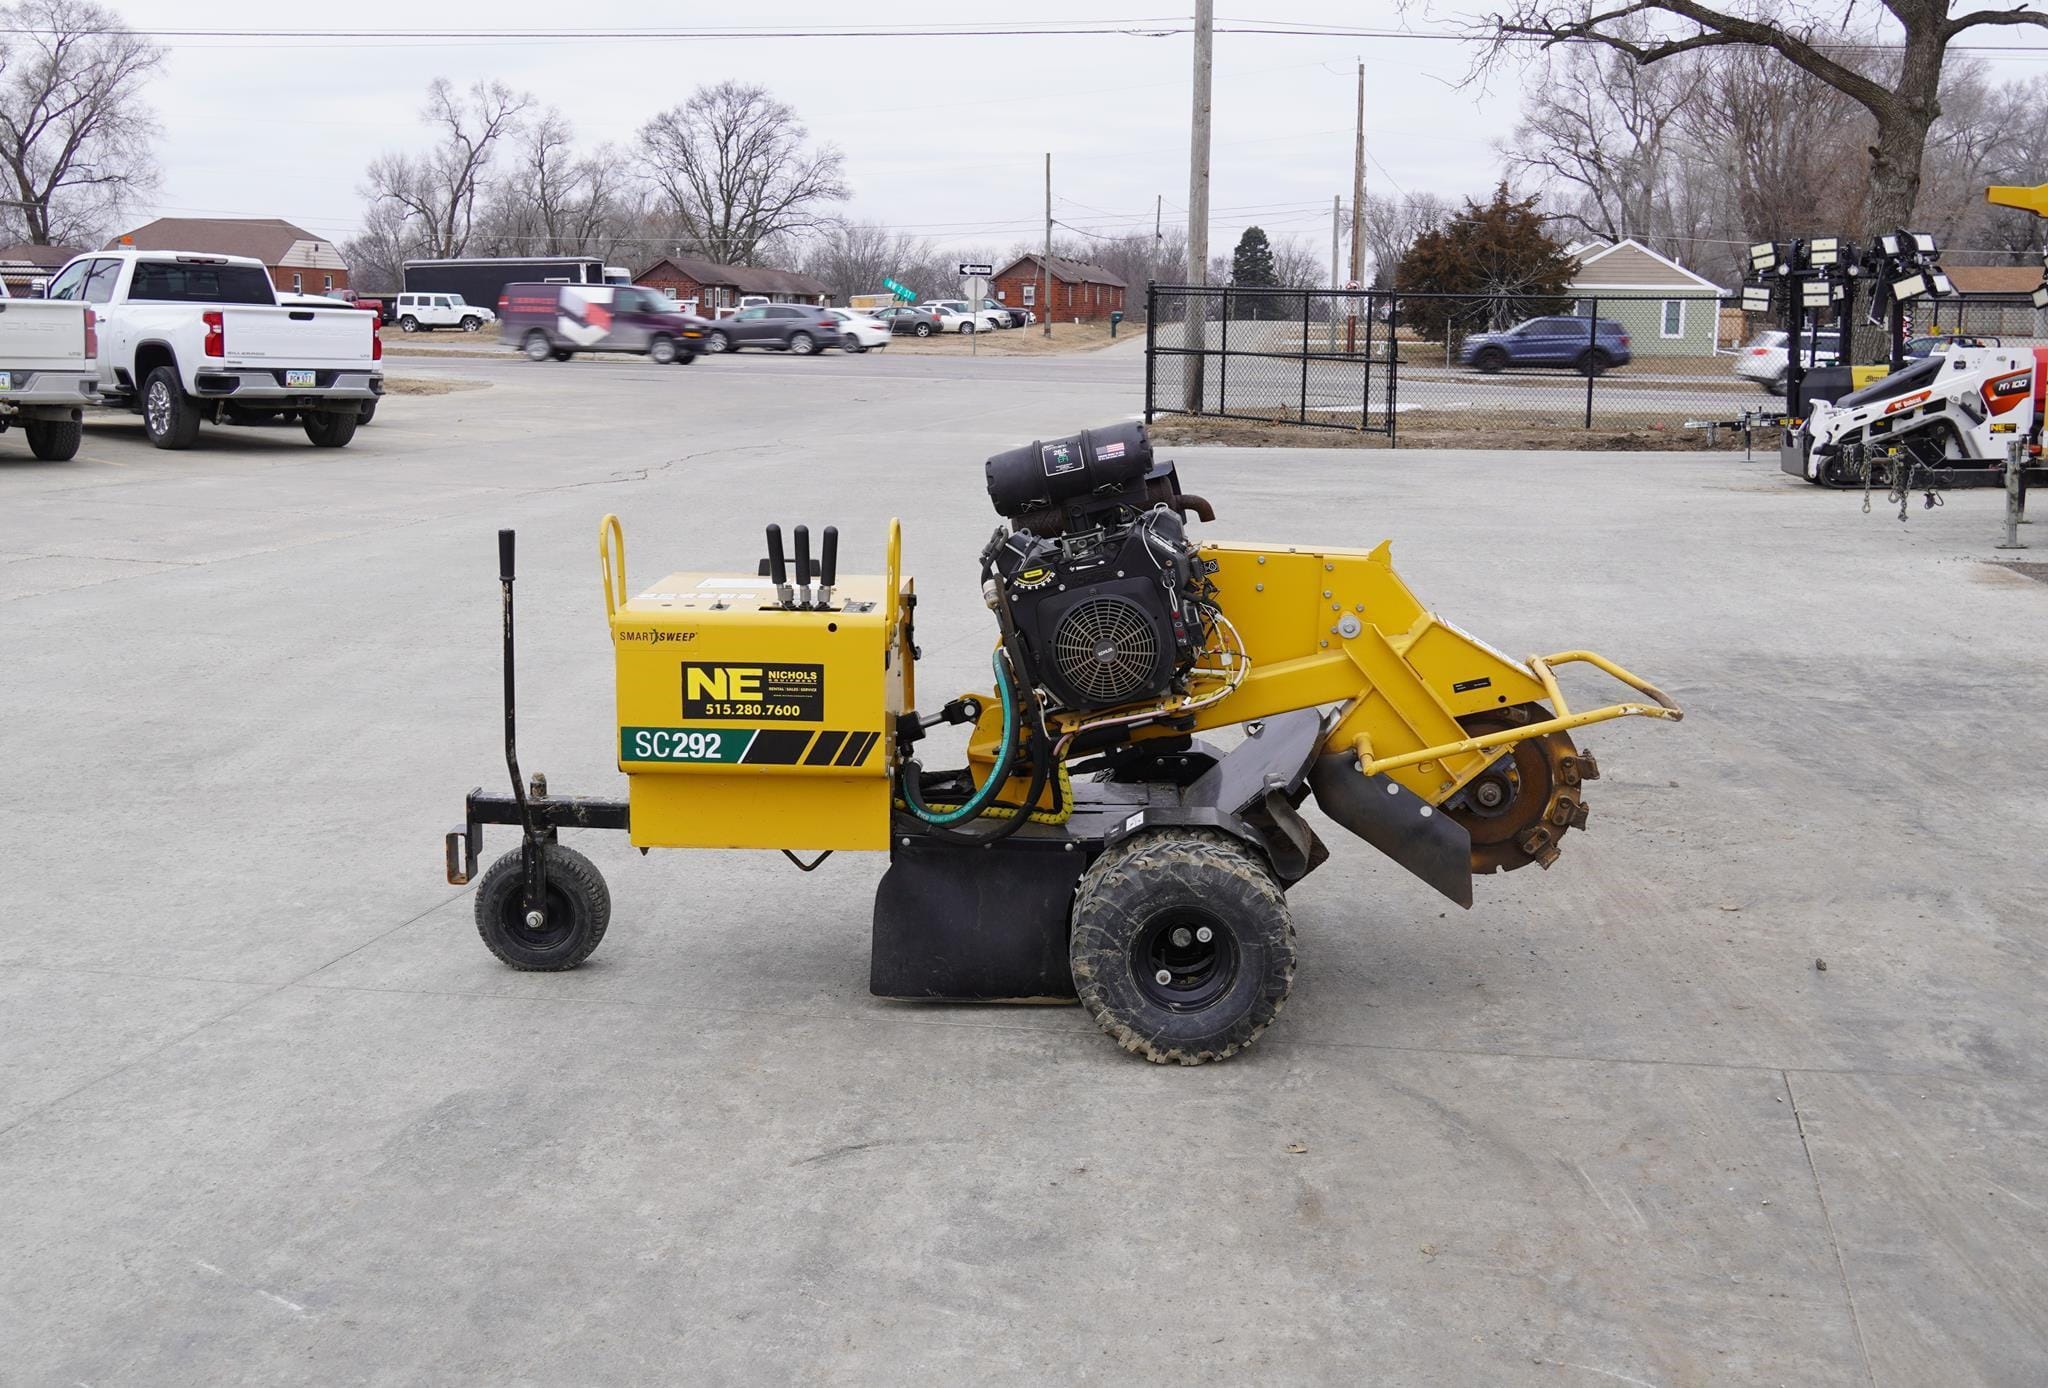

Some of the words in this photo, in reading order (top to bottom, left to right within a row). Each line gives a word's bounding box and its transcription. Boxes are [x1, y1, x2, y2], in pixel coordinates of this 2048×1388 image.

[619, 631, 655, 642] SMART
[658, 631, 696, 642] SWEEP
[768, 670, 818, 680] NICHOLS
[687, 667, 763, 701] NE
[705, 703, 801, 717] 515.280.7600
[635, 731, 722, 759] SC292
